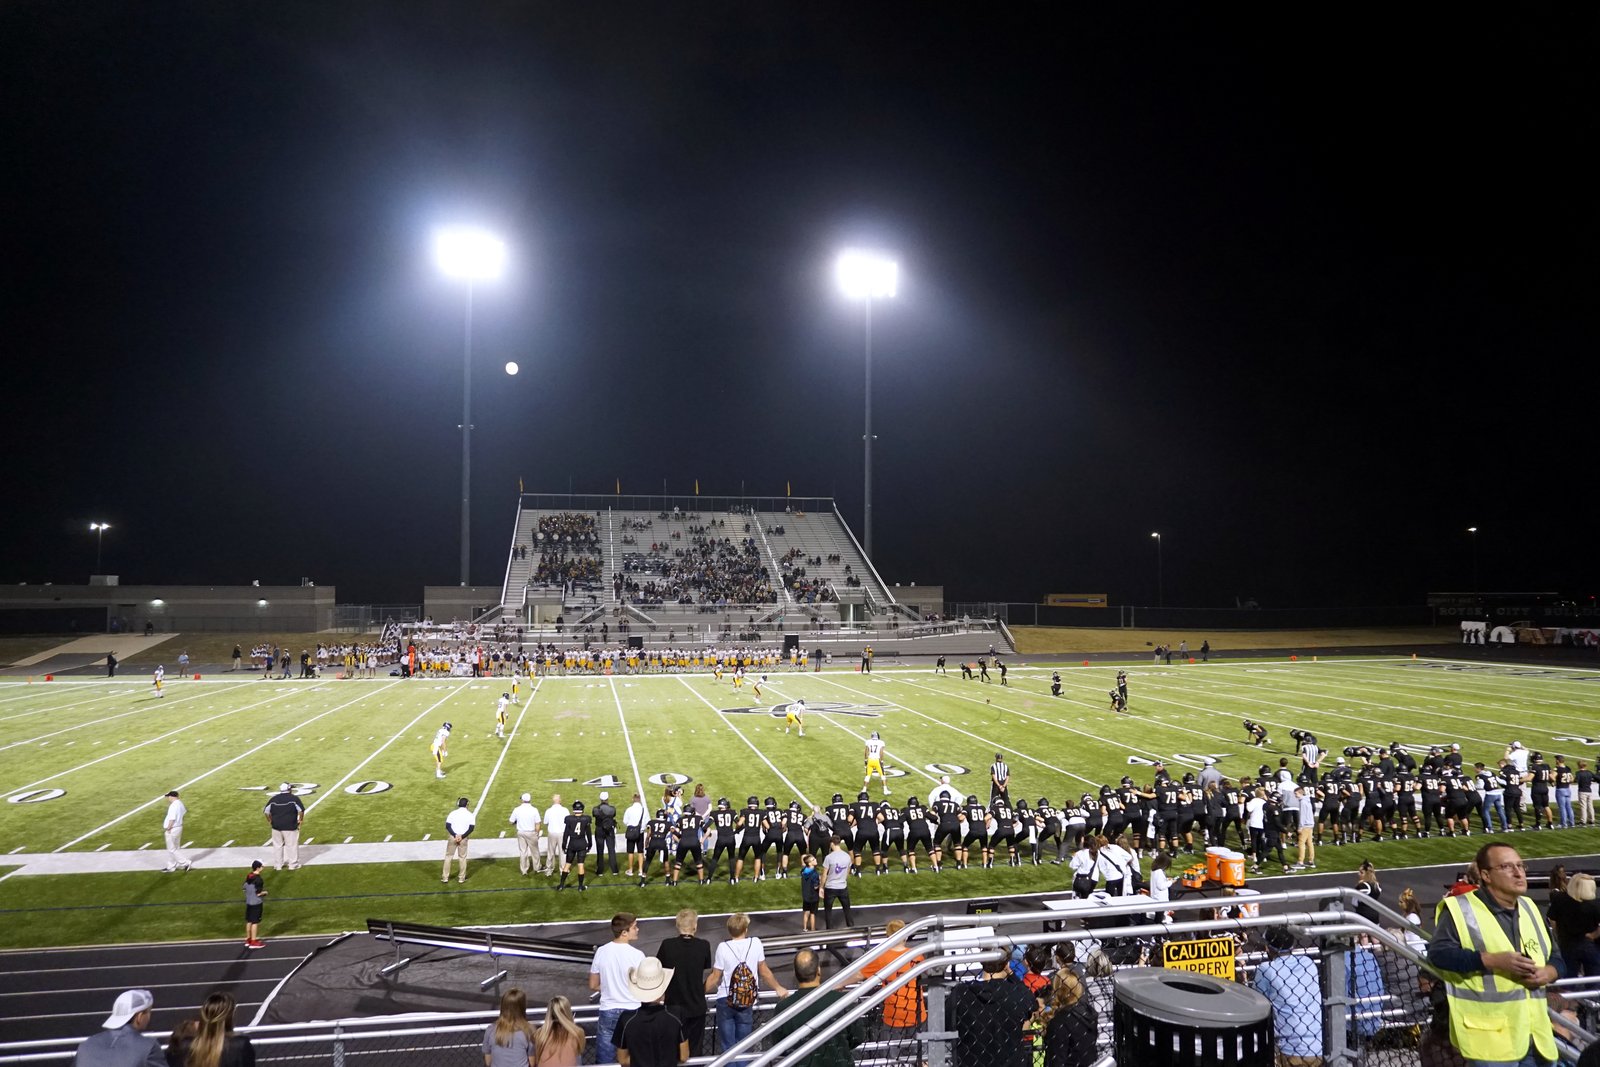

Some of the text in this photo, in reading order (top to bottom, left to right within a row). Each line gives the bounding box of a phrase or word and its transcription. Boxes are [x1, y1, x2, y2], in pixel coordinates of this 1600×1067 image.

[1496, 607, 1531, 616] CITY
[869, 744, 878, 753] 17
[1541, 769, 1549, 781] 11
[1264, 781, 1277, 793] 42
[1327, 783, 1338, 795] 31
[1367, 780, 1374, 792] 7
[1124, 792, 1139, 804] 75
[1165, 791, 1177, 804] 79
[1227, 792, 1238, 805] 16
[859, 805, 874, 819] 74
[942, 802, 955, 814] 77
[1086, 800, 1099, 811] 27
[768, 810, 782, 824] 82
[790, 811, 804, 825] 52
[833, 807, 847, 821] 78
[886, 806, 899, 821] 53
[909, 806, 924, 820] 65
[971, 808, 984, 822] 60
[1021, 808, 1035, 819] 34
[1042, 807, 1057, 819] 32
[1066, 808, 1081, 817] 30
[682, 814, 696, 829] 54
[717, 813, 732, 827] 50
[748, 813, 760, 828] 91
[574, 821, 581, 836] 4
[653, 822, 666, 834] 13
[1169, 941, 1229, 960] CAUTION
[1171, 961, 1229, 976] PPERY
